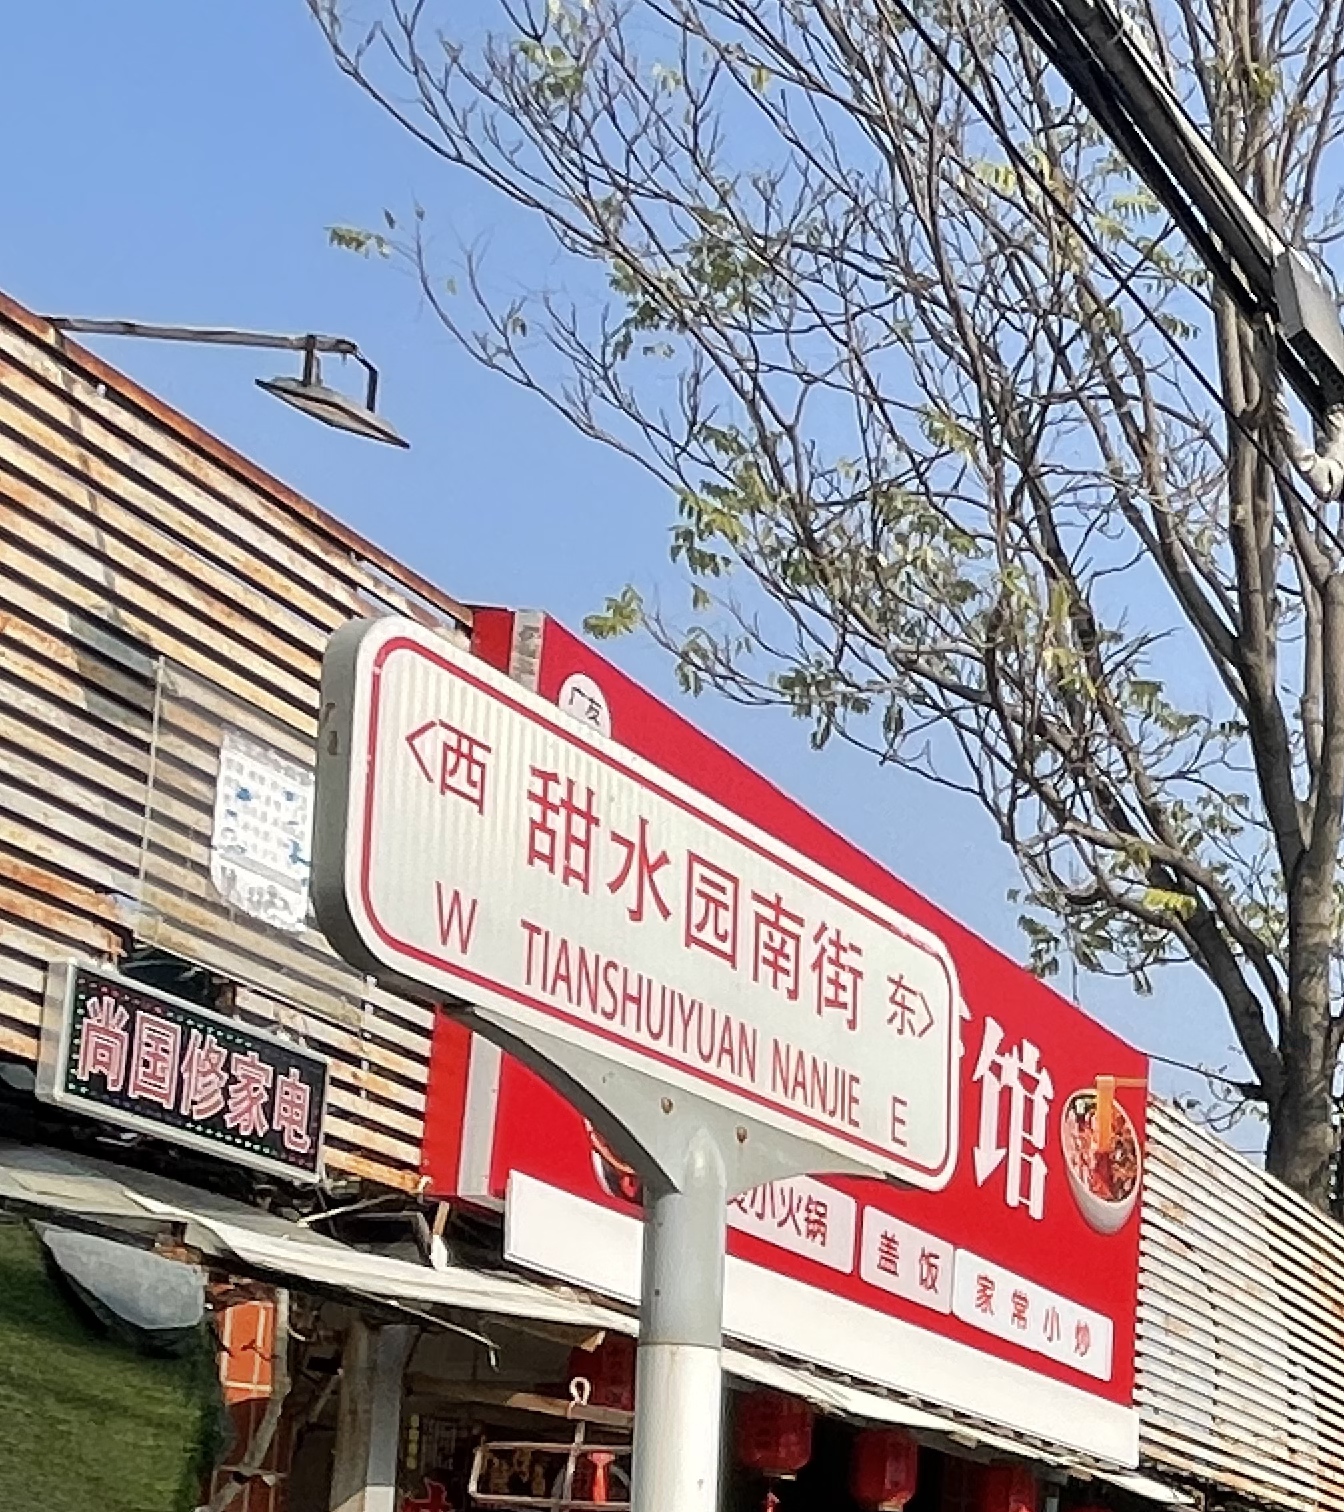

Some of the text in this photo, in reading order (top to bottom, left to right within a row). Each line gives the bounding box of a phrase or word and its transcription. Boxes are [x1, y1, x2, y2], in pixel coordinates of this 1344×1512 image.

[438, 718, 919, 1036] 西 甜水园南街 东
[76, 995, 312, 1154] 尚国修家电
[435, 880, 908, 1147] W TIANSHUIYUAN NANJIE E
[961, 980, 1054, 1220] 馆
[876, 1229, 940, 1295] 盖饭
[974, 1272, 1092, 1358] 家常小炒
